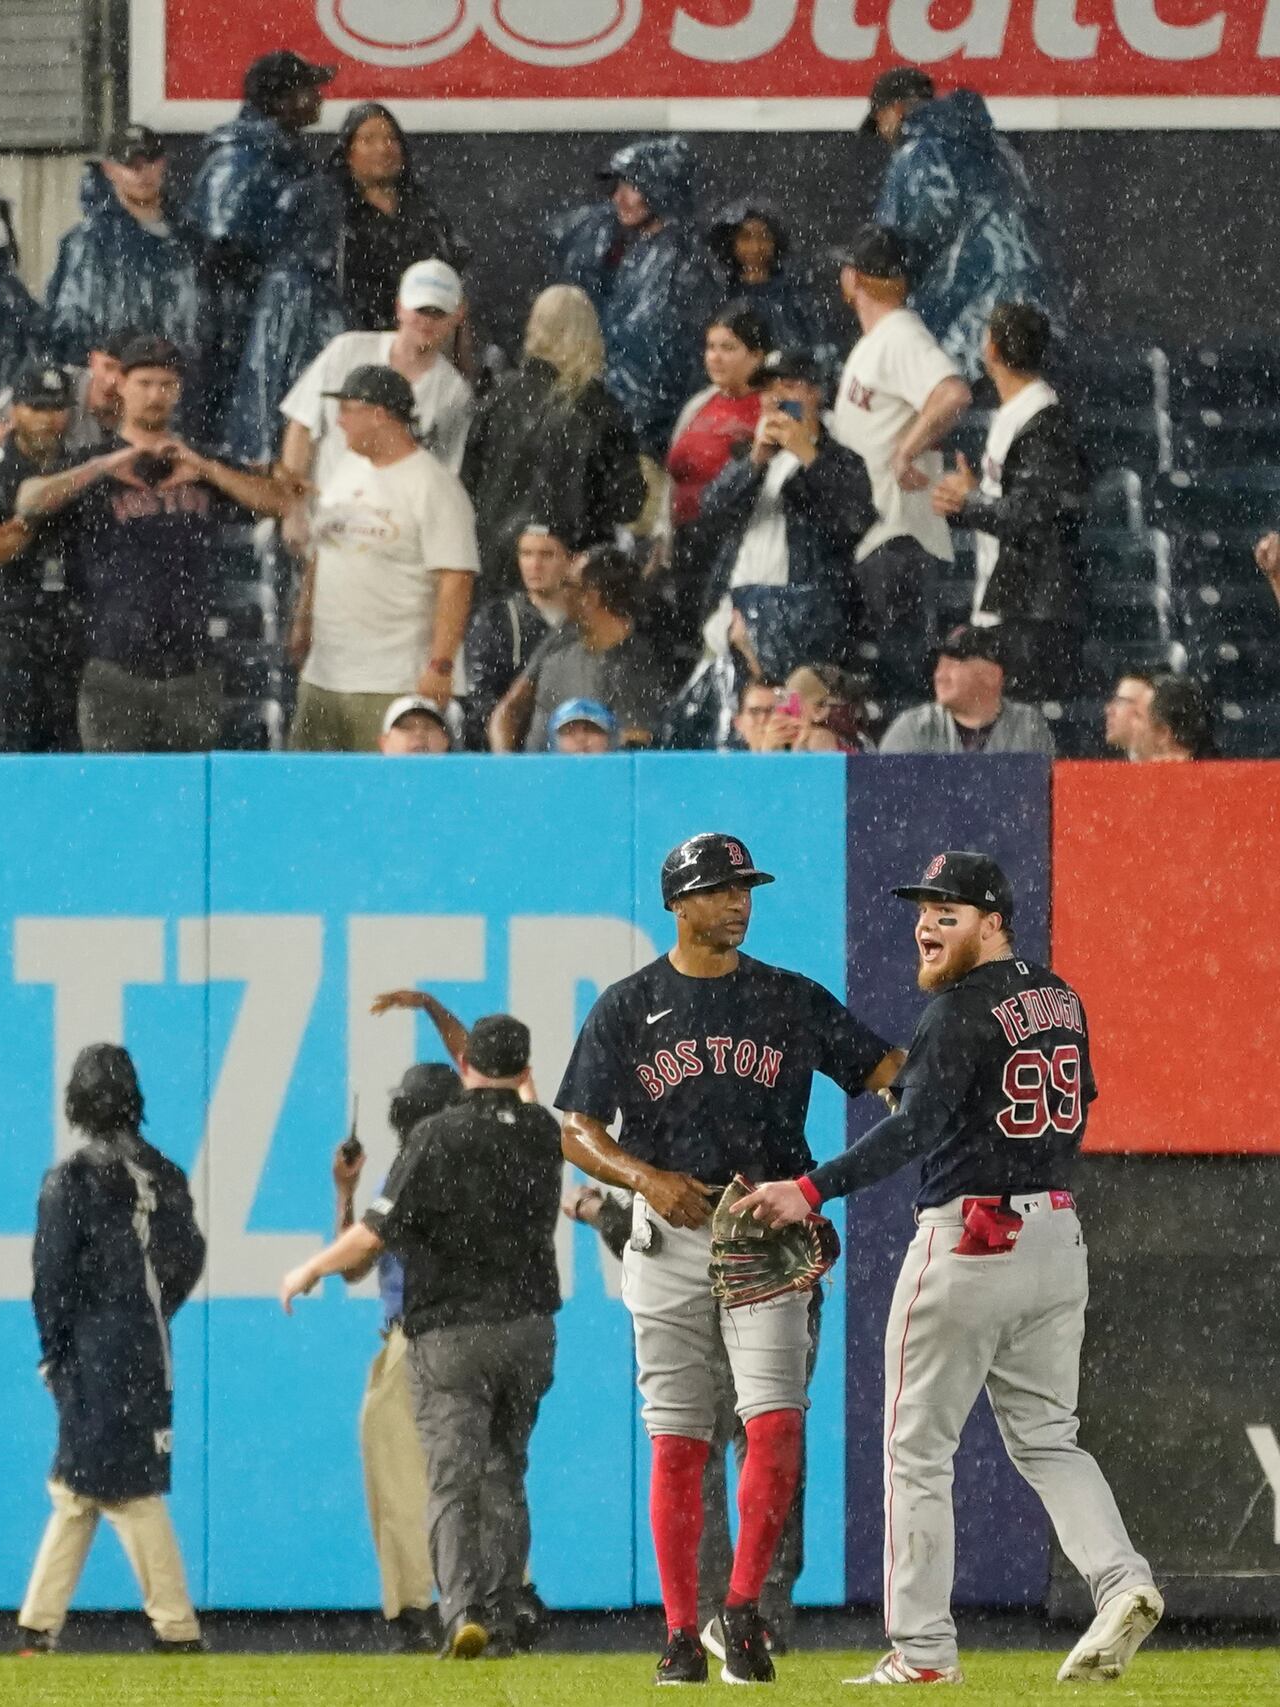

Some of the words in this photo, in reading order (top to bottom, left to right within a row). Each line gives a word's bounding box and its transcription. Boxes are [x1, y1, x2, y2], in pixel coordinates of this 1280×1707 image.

[725, 842, 744, 865] B
[924, 854, 947, 880] B
[635, 1036, 783, 1100] BOSTON
[996, 1045, 1082, 1138] 99
